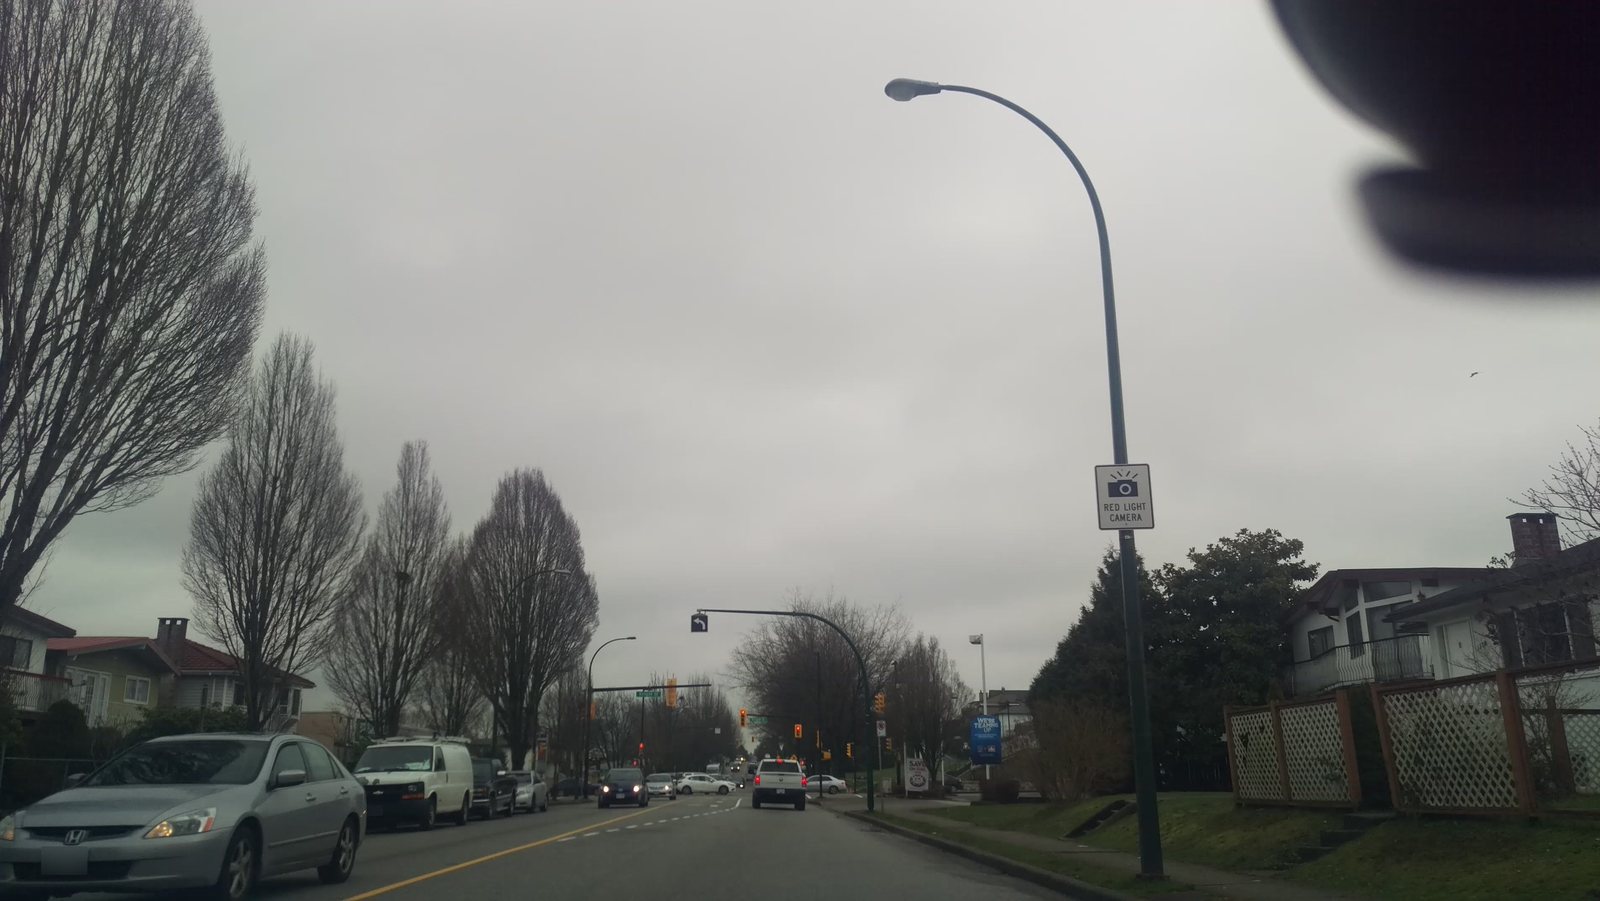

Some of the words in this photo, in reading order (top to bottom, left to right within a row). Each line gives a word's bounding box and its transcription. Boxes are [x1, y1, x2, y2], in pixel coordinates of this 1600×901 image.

[1103, 503, 1120, 512] RED
[1123, 502, 1146, 511] LIGHT
[1109, 513, 1143, 522] CAMERA
